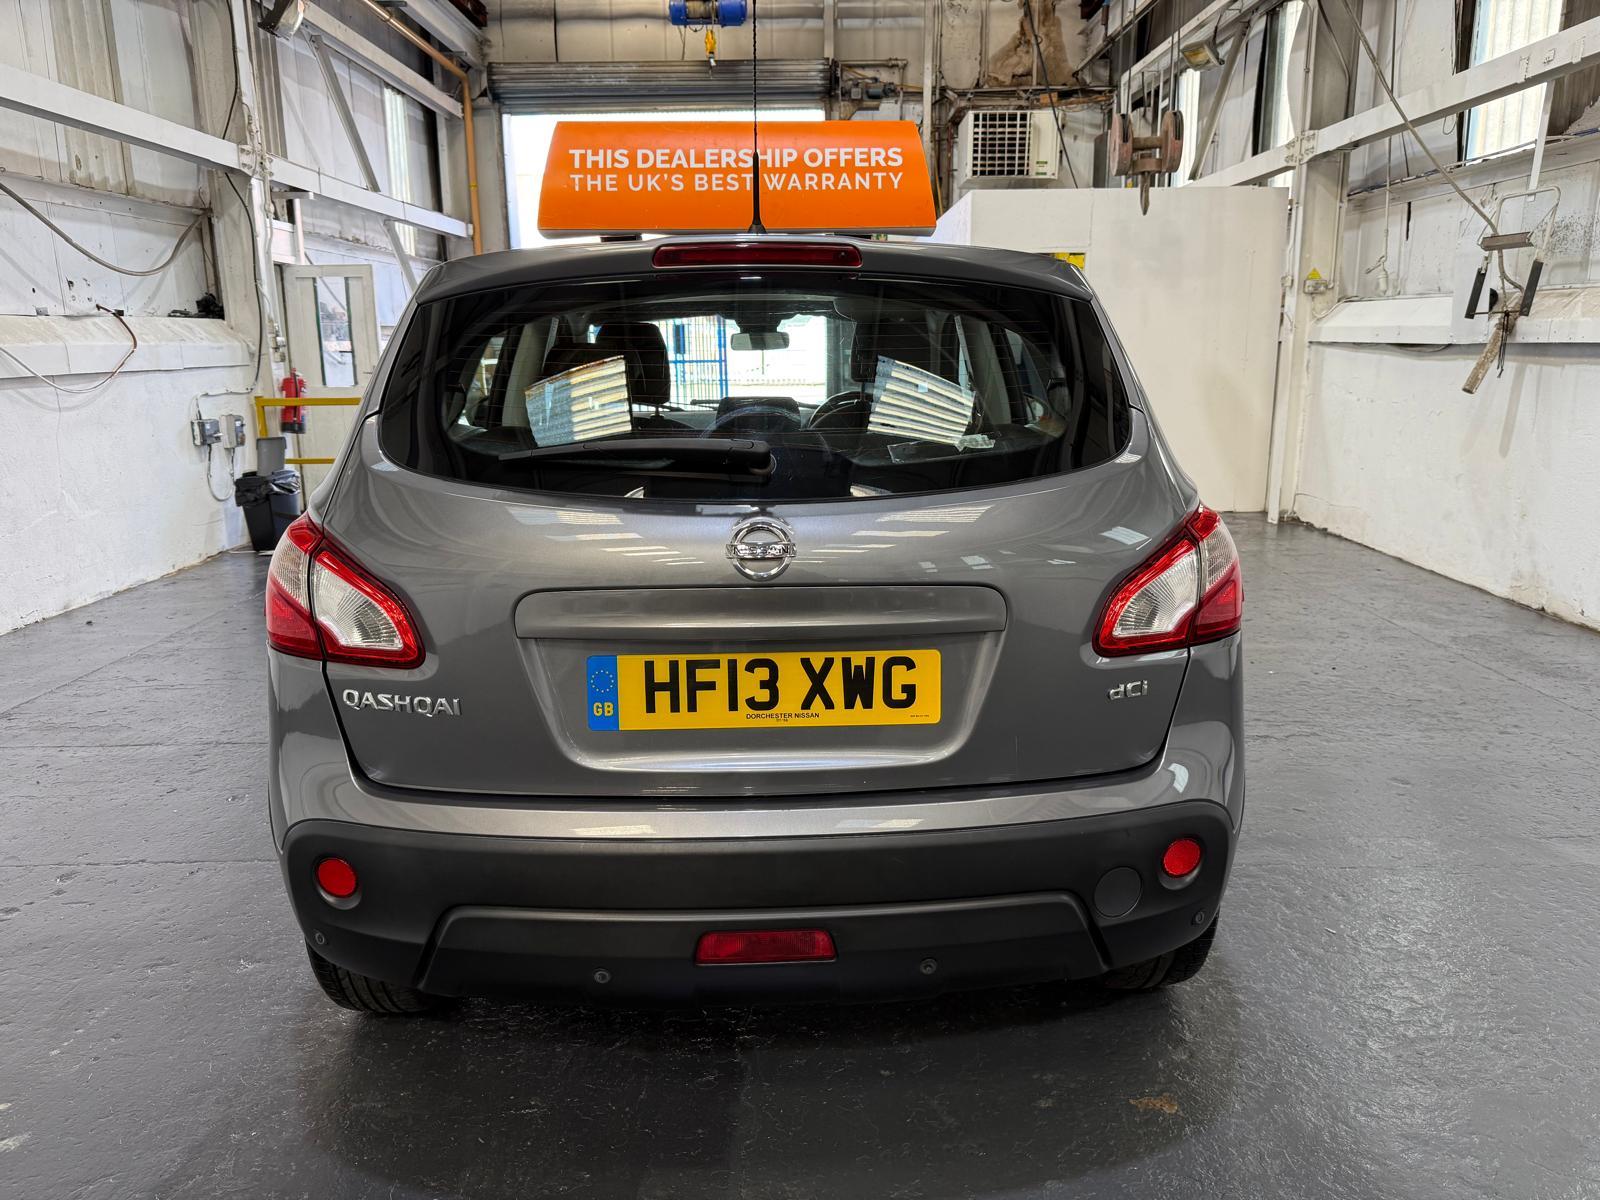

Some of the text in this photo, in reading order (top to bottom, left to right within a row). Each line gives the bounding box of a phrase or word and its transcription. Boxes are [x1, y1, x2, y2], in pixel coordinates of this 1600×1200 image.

[569, 147, 904, 169] THIS DEALERSHIP OFFERS
[569, 172, 903, 191] THE UK'S BEST WARRANTY
[644, 655, 917, 713] HF13 XWG
[1109, 680, 1148, 700] dCi
[342, 689, 460, 717] QASHQAI
[593, 702, 614, 716] GB
